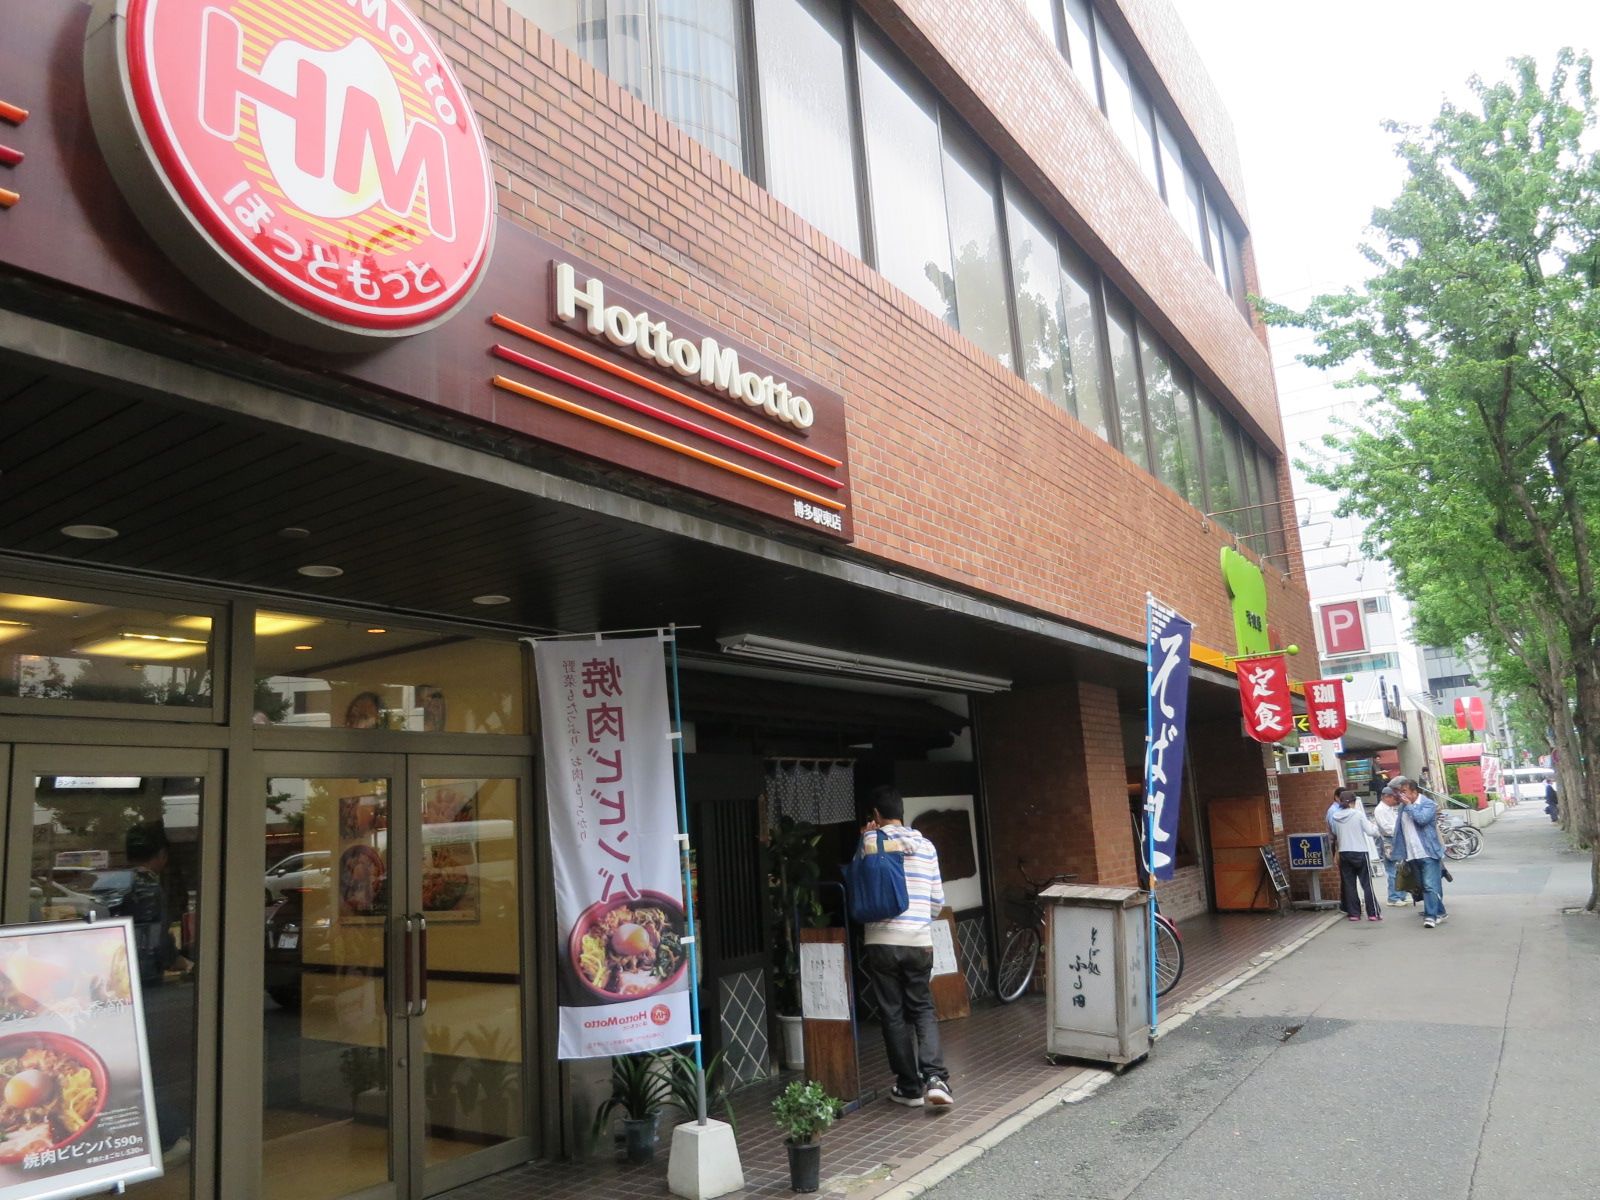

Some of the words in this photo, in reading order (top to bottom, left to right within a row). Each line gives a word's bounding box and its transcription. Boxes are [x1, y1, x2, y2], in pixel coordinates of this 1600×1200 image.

[199, 6, 456, 243] HM
[222, 180, 442, 300] ほっともっと
[556, 262, 815, 430] HottoMotto
[793, 499, 842, 532] 博多駅東店
[1328, 609, 1354, 648] P
[1248, 666, 1285, 732] 定食
[1312, 684, 1339, 729] 珈琲
[1293, 858, 1323, 866] COFFEE
[1307, 851, 1322, 859] KEY
[23, 1136, 113, 1170] 焼肉ビビンバ
